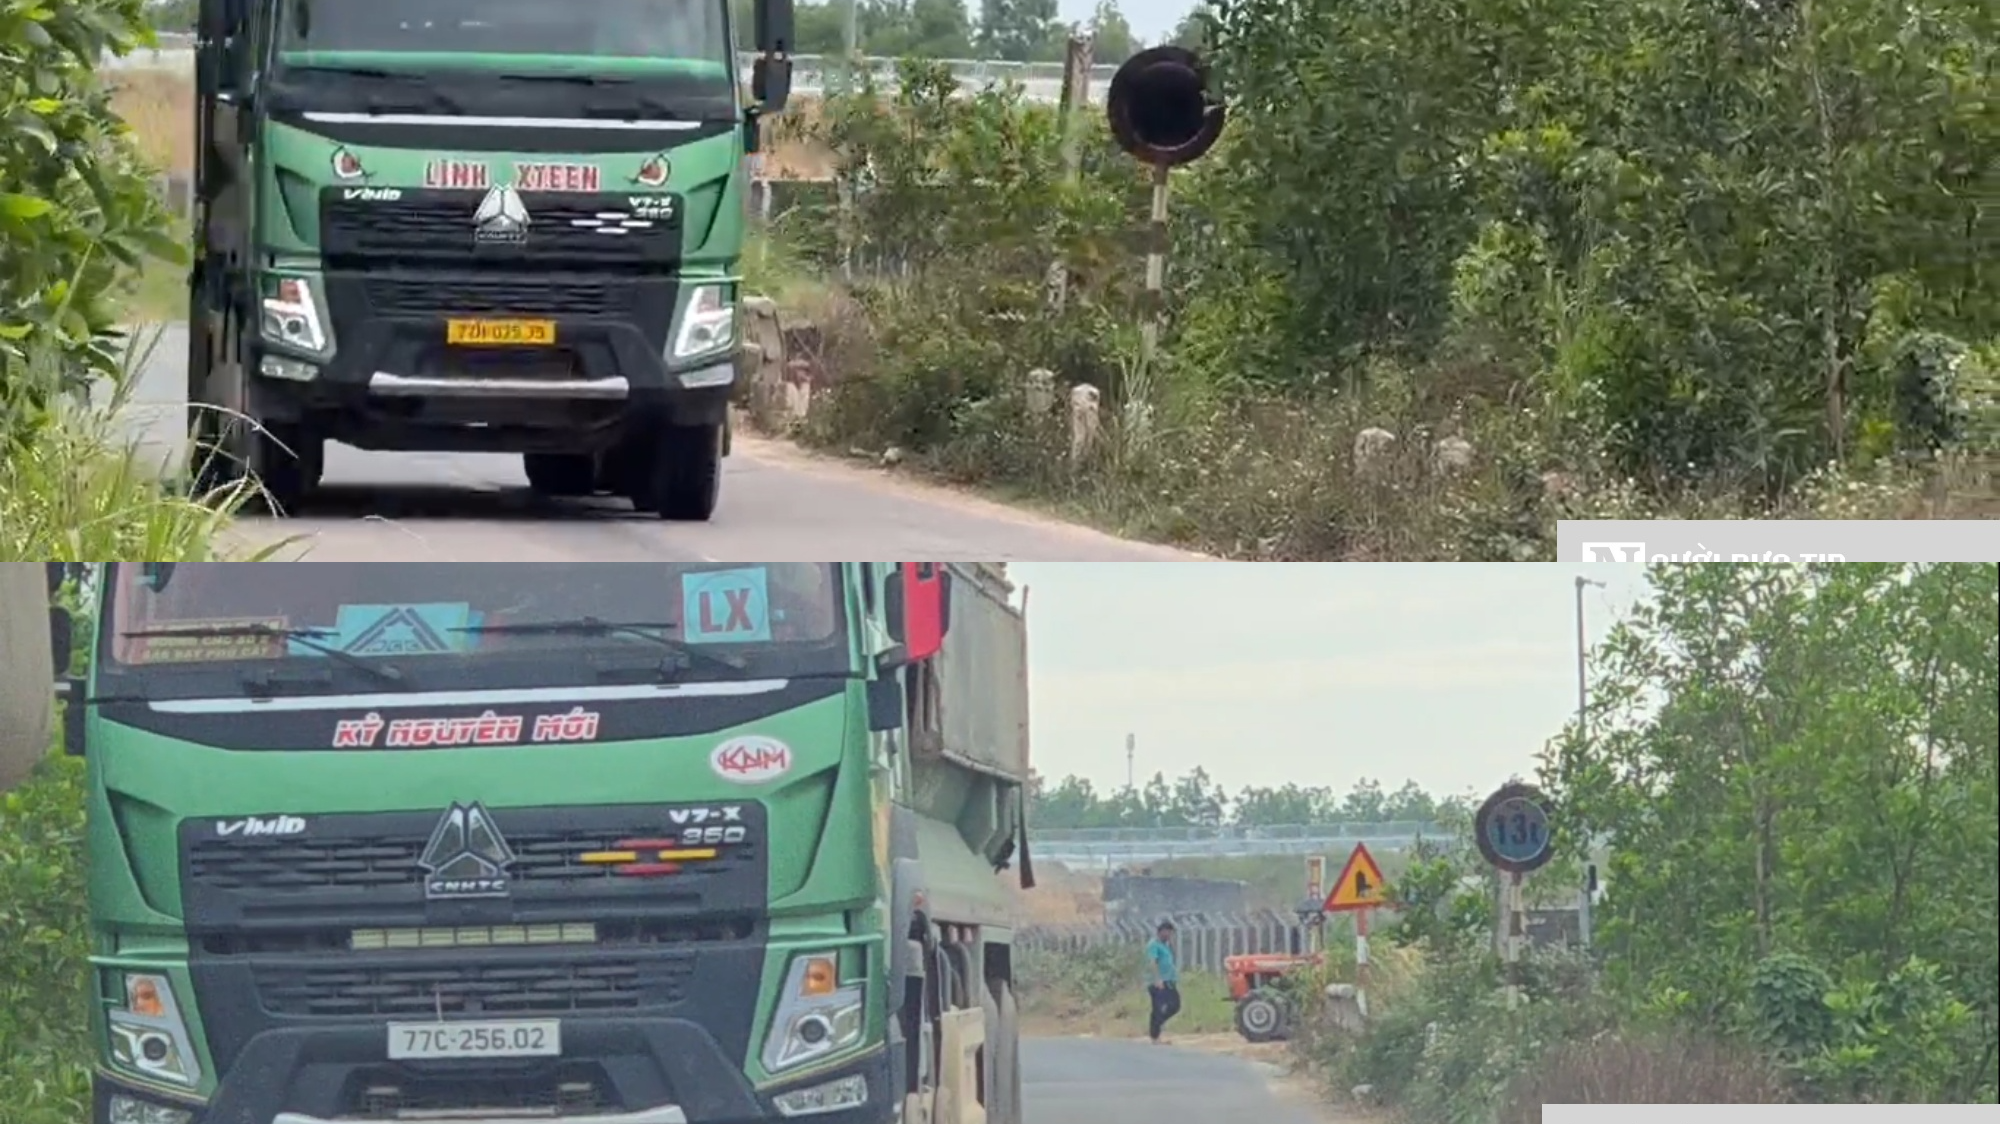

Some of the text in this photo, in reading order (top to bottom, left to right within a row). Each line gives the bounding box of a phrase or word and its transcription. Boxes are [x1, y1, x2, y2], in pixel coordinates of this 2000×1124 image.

[698, 588, 754, 633] LX
[669, 806, 742, 824] V7-X
[402, 1027, 545, 1052] 77C-256.02
